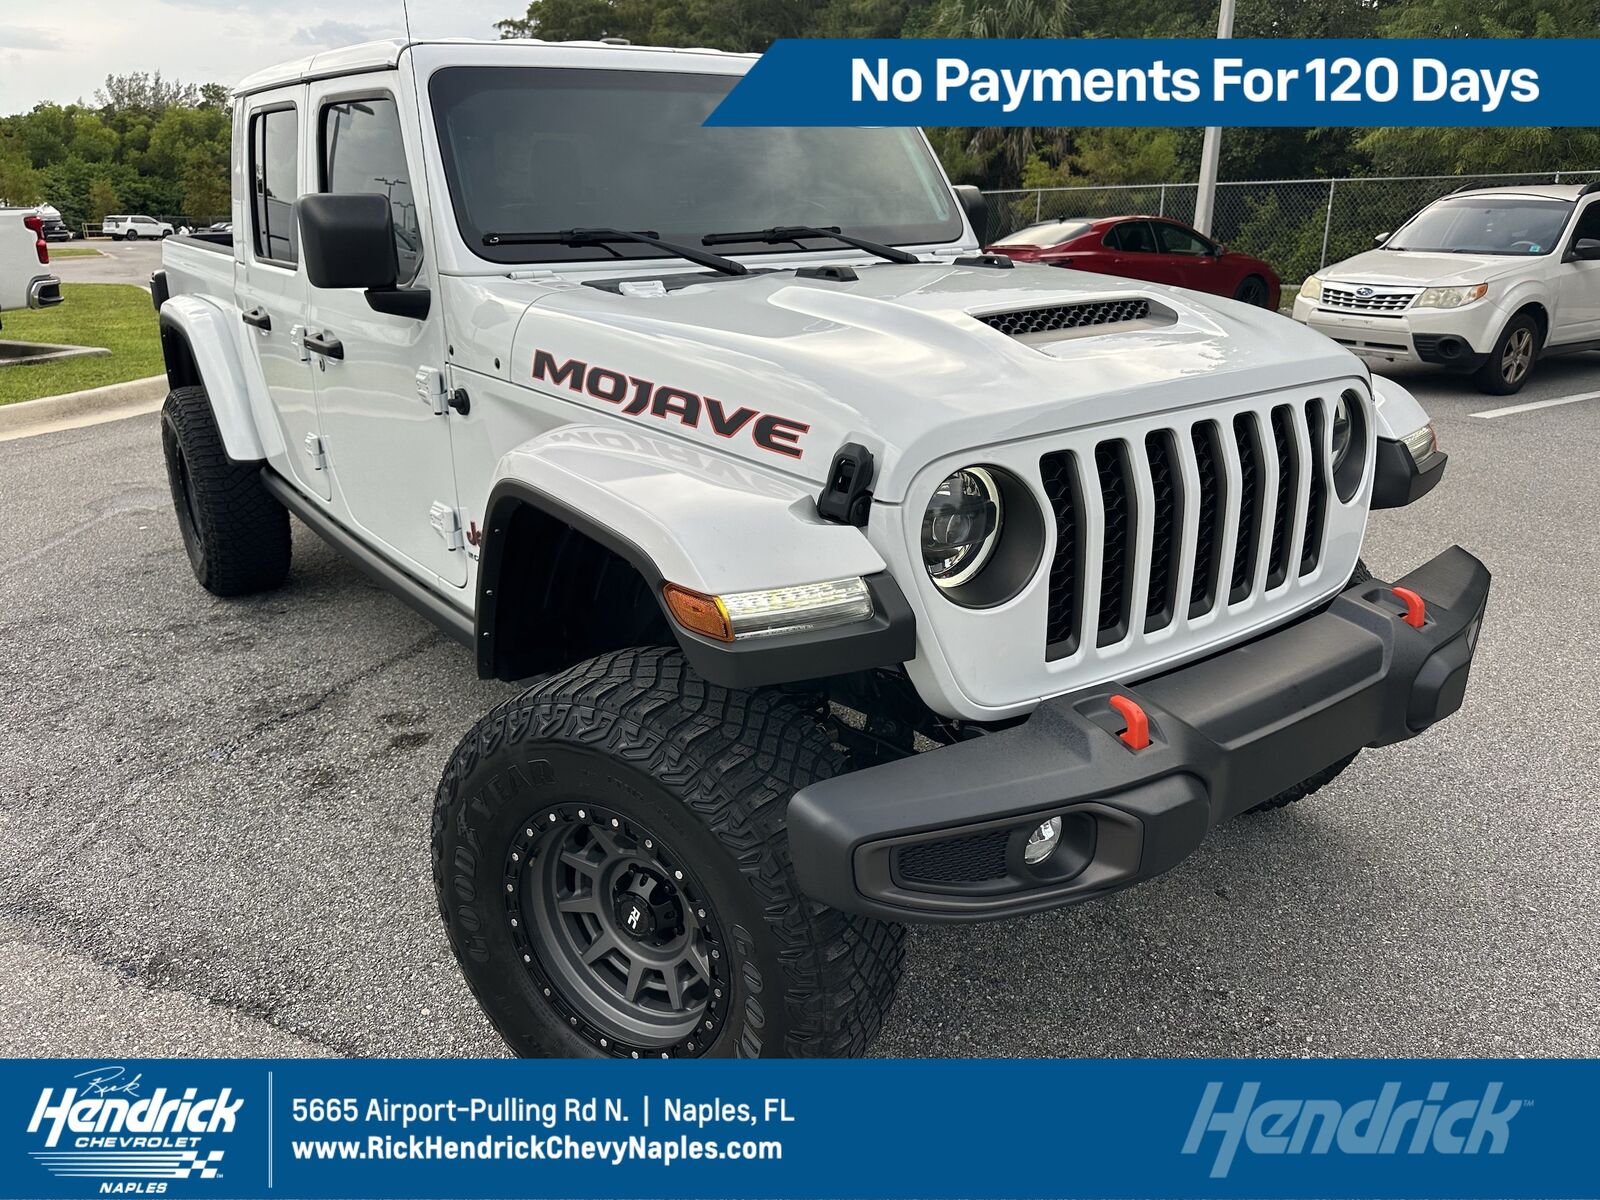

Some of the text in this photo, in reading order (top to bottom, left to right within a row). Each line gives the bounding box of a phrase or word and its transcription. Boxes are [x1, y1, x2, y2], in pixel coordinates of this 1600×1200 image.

[532, 348, 811, 460] MOJAVE
[454, 758, 559, 964] GOOD YEAR
[627, 906, 641, 930] RC
